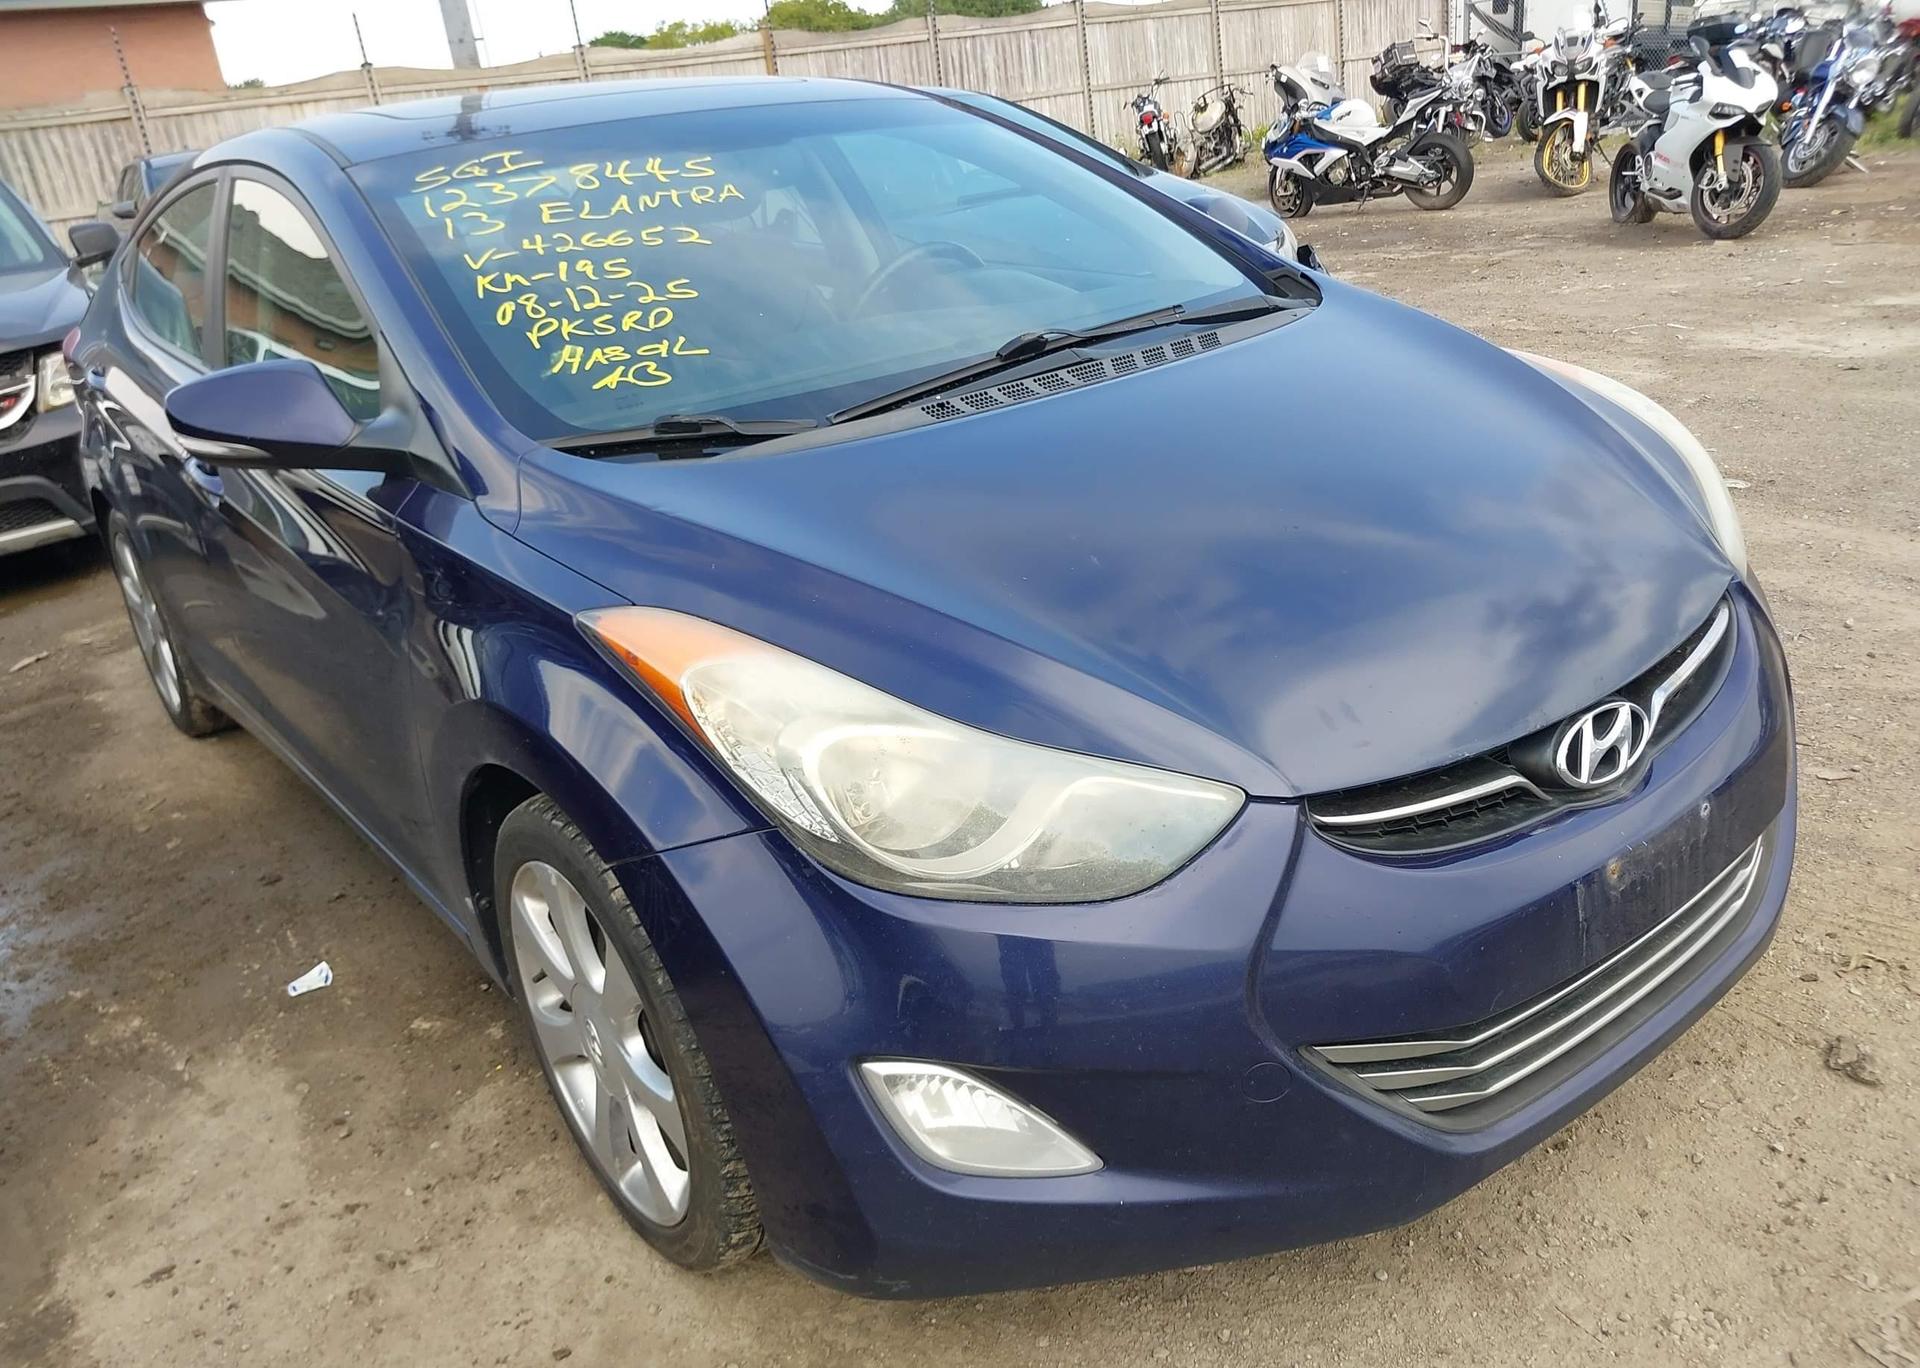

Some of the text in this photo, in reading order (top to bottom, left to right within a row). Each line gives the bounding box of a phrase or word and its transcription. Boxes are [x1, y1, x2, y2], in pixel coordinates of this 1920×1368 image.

[411, 150, 544, 193] SGI
[445, 183, 746, 240] 13 ELANTRA
[496, 278, 700, 326] 08-12-25
[526, 306, 675, 349] PKSRD
